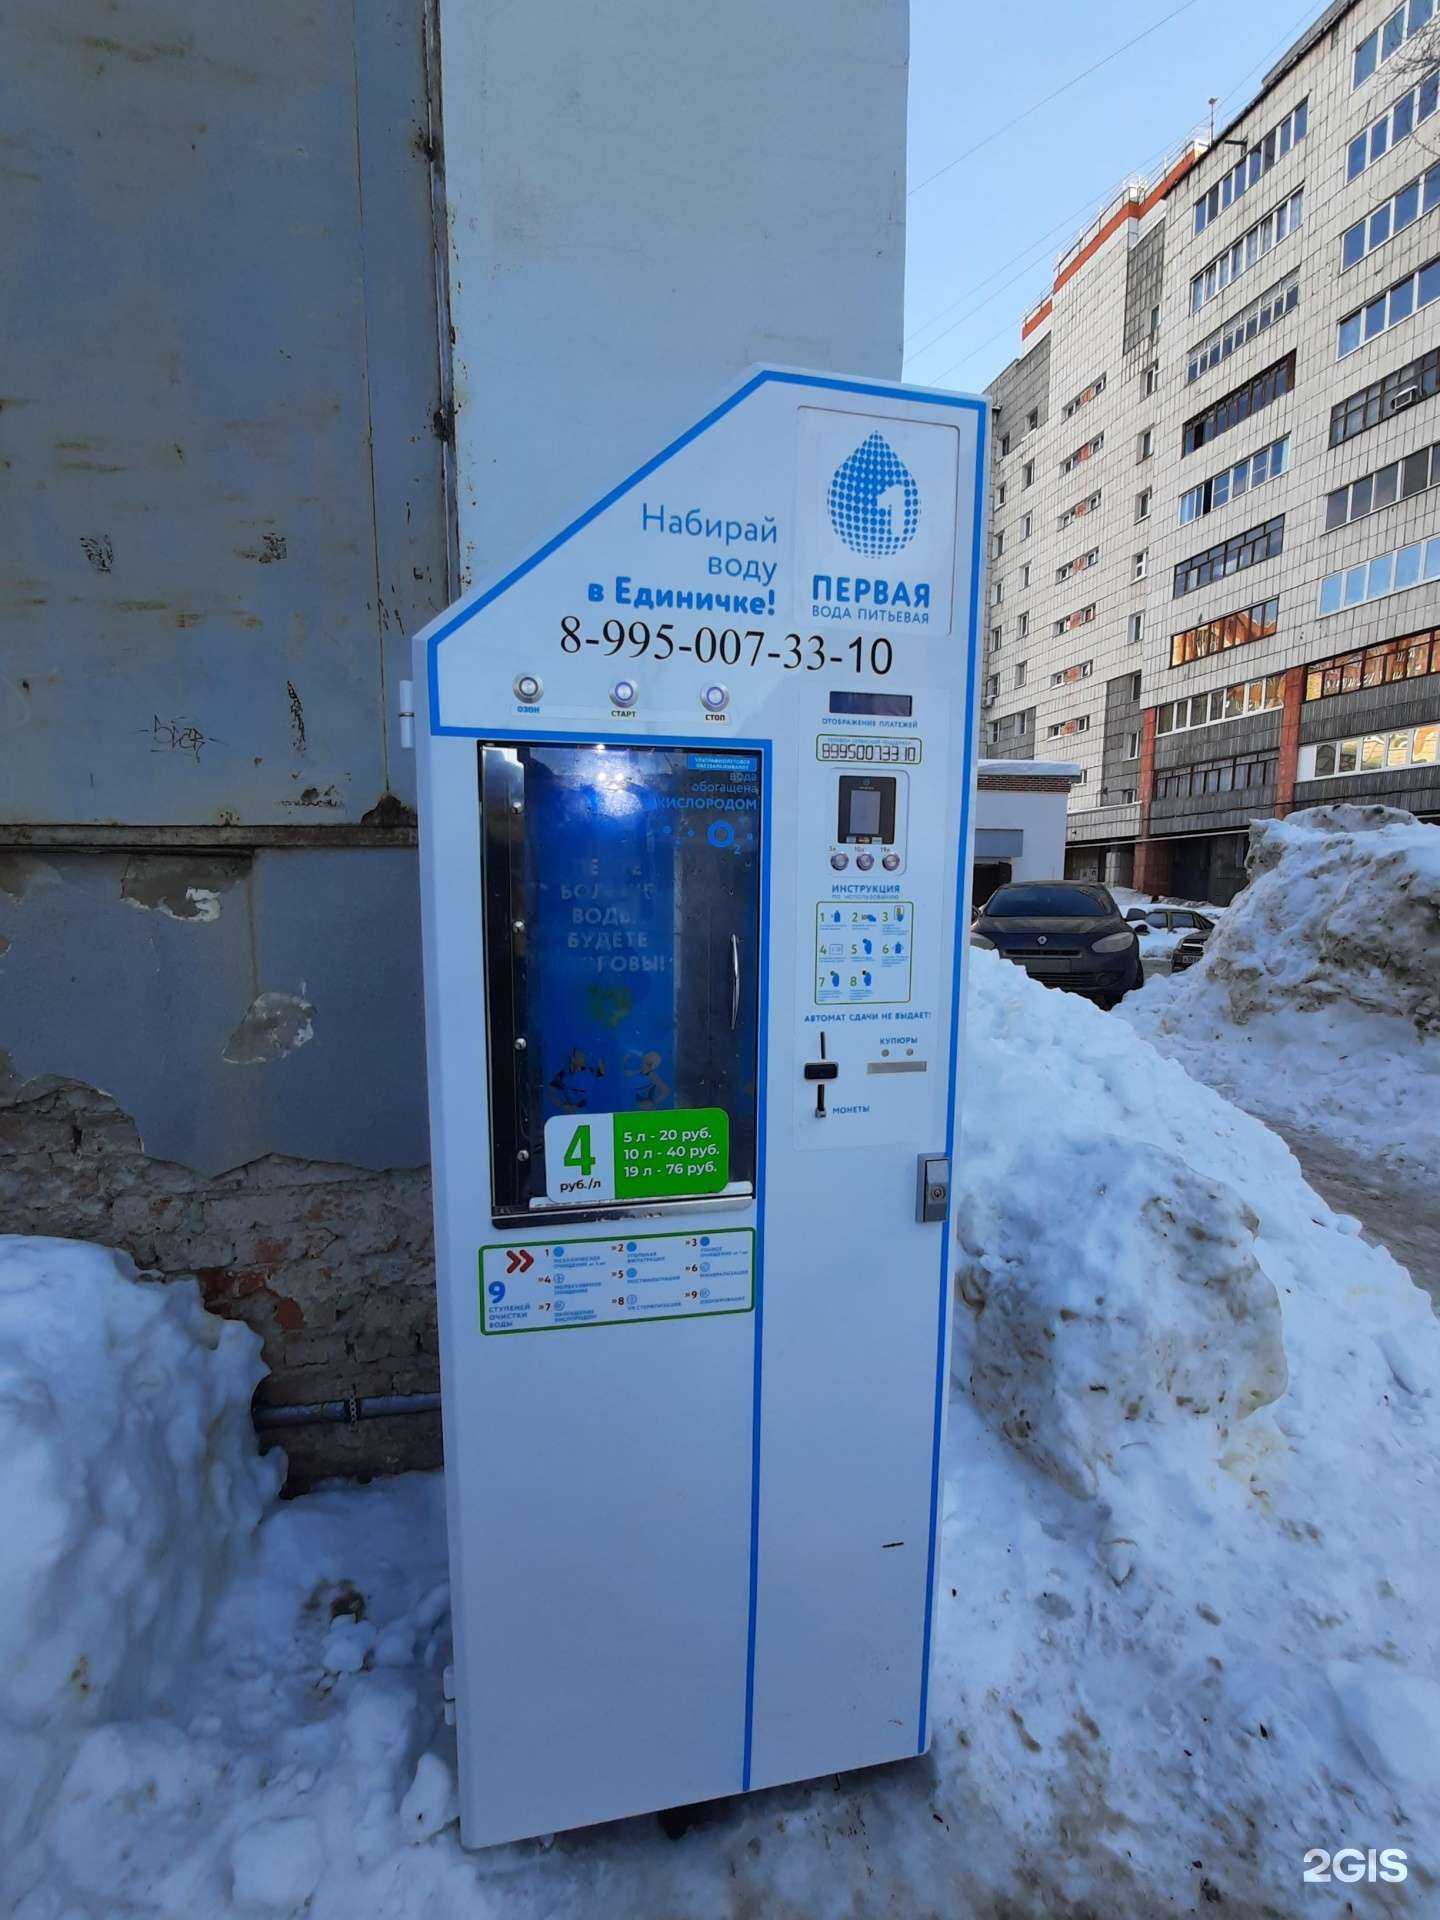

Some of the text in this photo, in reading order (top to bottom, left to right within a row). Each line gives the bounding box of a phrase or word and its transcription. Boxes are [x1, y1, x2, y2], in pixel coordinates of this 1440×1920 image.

[641, 502, 778, 546] Набирай
[707, 555, 778, 585] воду
[587, 576, 776, 617] в Единичке!
[811, 574, 931, 609] ПЕРВАЯ
[811, 604, 930, 625] ВОДА ПИТЬЕВАЯ
[559, 614, 894, 676] 8-995-007-33-10
[516, 705, 540, 714] ОЗОН
[610, 709, 637, 719] СТАРТ
[704, 713, 726, 722] СТОП
[822, 717, 918, 729] ОТОБРАЖЕНИЕ ПЛАТЕЖЕЙ
[822, 743, 916, 762] 89950073310
[730, 772, 757, 783] вода
[692, 781, 757, 794] обогащена
[655, 798, 757, 812] КИСЛОРОДОМ
[831, 884, 901, 894] ИНСТРУКЦИЯ
[819, 912, 826, 922] 1
[851, 912, 858, 922] 2
[882, 912, 889, 922] 3
[819, 945, 827, 954] 4
[850, 945, 858, 954] 5
[882, 945, 889, 954] 6
[818, 977, 825, 987] 7
[850, 976, 857, 986] 8
[804, 1014, 846, 1022] АВТОМАТ
[849, 1013, 879, 1022] СДАЧИ
[895, 1011, 932, 1020] ВЫДАЕТ!
[880, 1036, 918, 1045] КУПЮРЫ
[832, 1105, 870, 1115] МОНЕТЫ
[623, 1132, 632, 1143] 5
[636, 1133, 646, 1142] л
[659, 1130, 677, 1141] 20
[682, 1127, 712, 1142] руб.
[563, 1124, 597, 1176] 4
[624, 1149, 640, 1160] 10
[642, 1150, 653, 1159] л
[667, 1146, 686, 1157] 40
[690, 1144, 720, 1159] руб.
[624, 1166, 639, 1177] 19
[642, 1167, 652, 1176] л
[665, 1163, 684, 1175] 76
[687, 1162, 717, 1176] руб.
[560, 1179, 601, 1193] руб./л
[488, 1280, 506, 1304] 9
[488, 1302, 530, 1314] СТУПЕНЕЙ
[489, 1311, 528, 1322] ОЧИСТКИ
[489, 1320, 514, 1329] ВОДЫ
